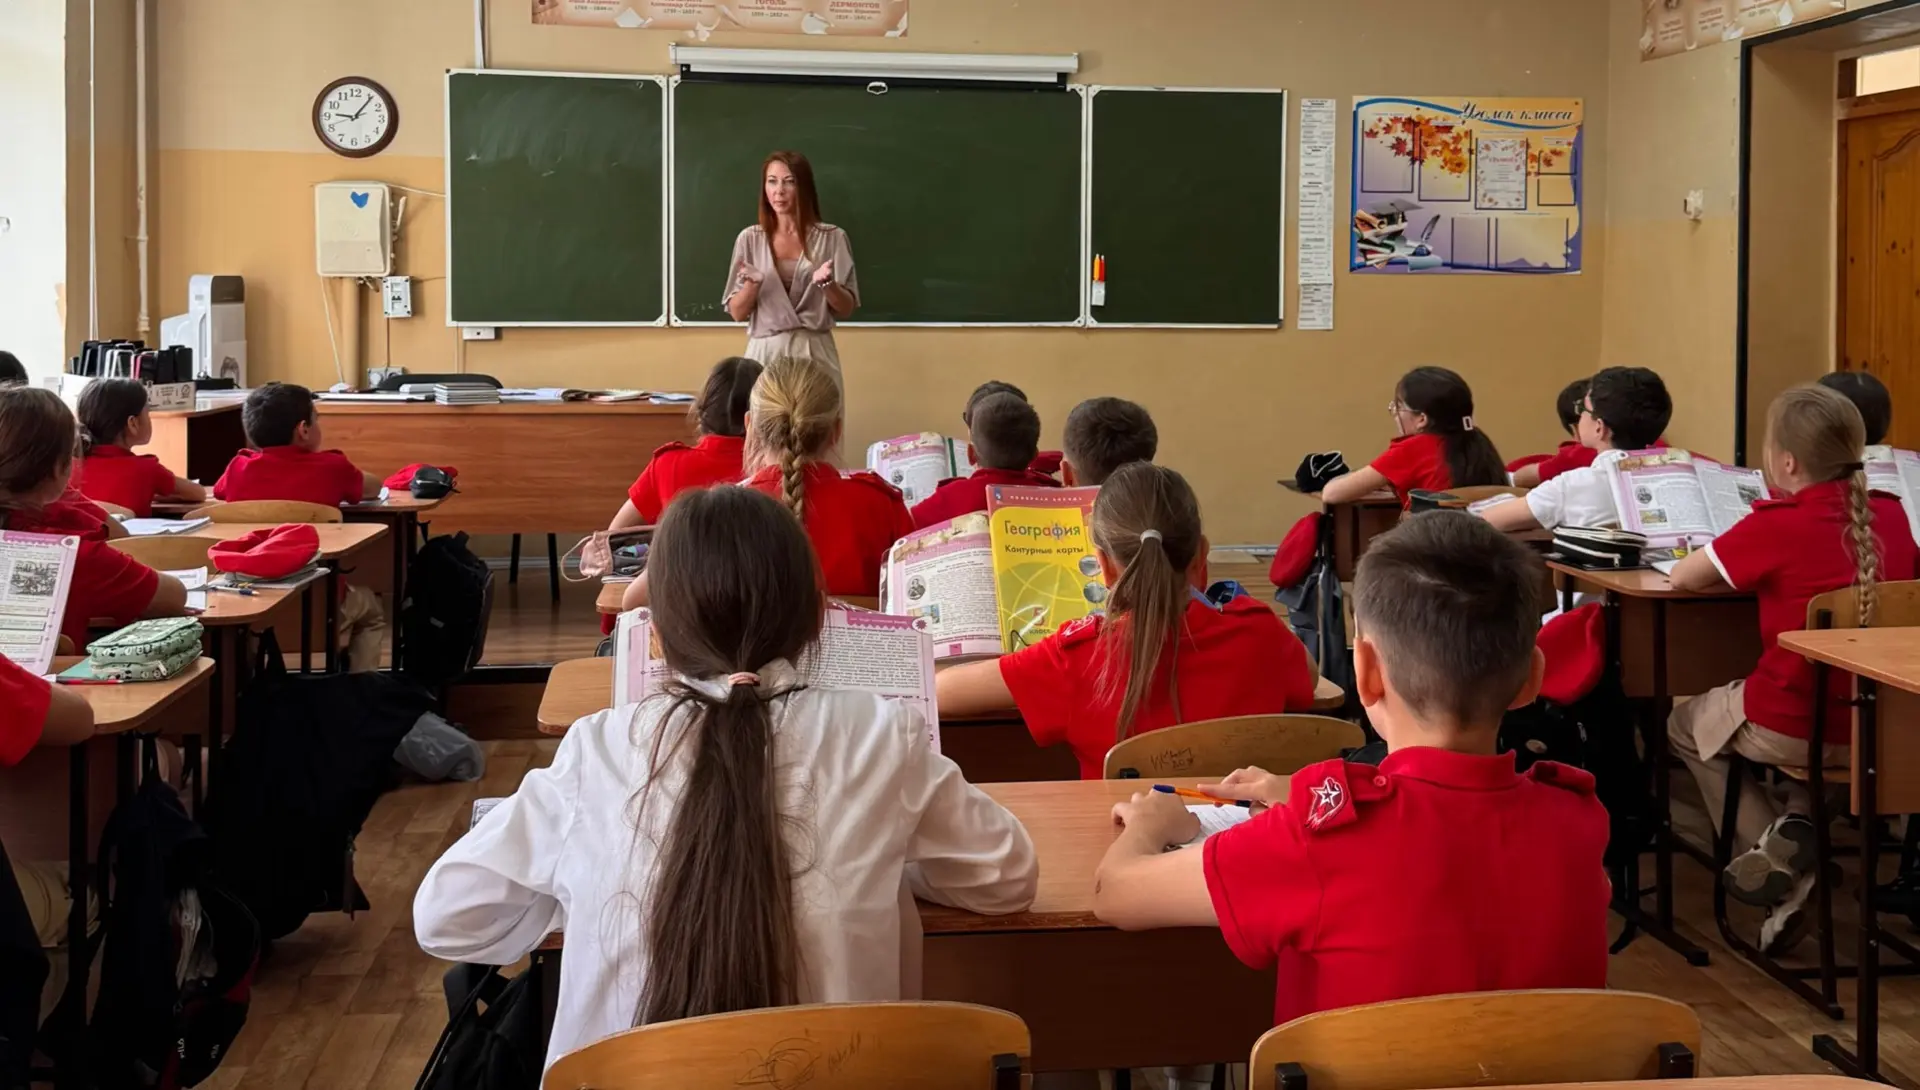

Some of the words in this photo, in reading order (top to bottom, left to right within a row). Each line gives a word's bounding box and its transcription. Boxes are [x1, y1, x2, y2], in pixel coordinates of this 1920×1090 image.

[829, 1, 880, 9] ЛЕРМОНТОВ
[338, 91, 348, 101] 11
[349, 88, 362, 98] 12
[328, 100, 340, 110] 10
[374, 103, 382, 112] 2
[1460, 101, 1514, 120] Уголок
[1519, 110, 1573, 120] класса
[323, 112, 331, 121] 9
[378, 114, 385, 124] 3
[328, 123, 335, 133] 8
[373, 126, 380, 135] 4
[338, 133, 345, 142] 7
[350, 137, 358, 146] 6
[364, 134, 371, 144] 5
[1004, 520, 1081, 541] География
[1005, 544, 1053, 556] Контурные
[1056, 545, 1084, 556] карты
[1032, 606, 1046, 626] 5
